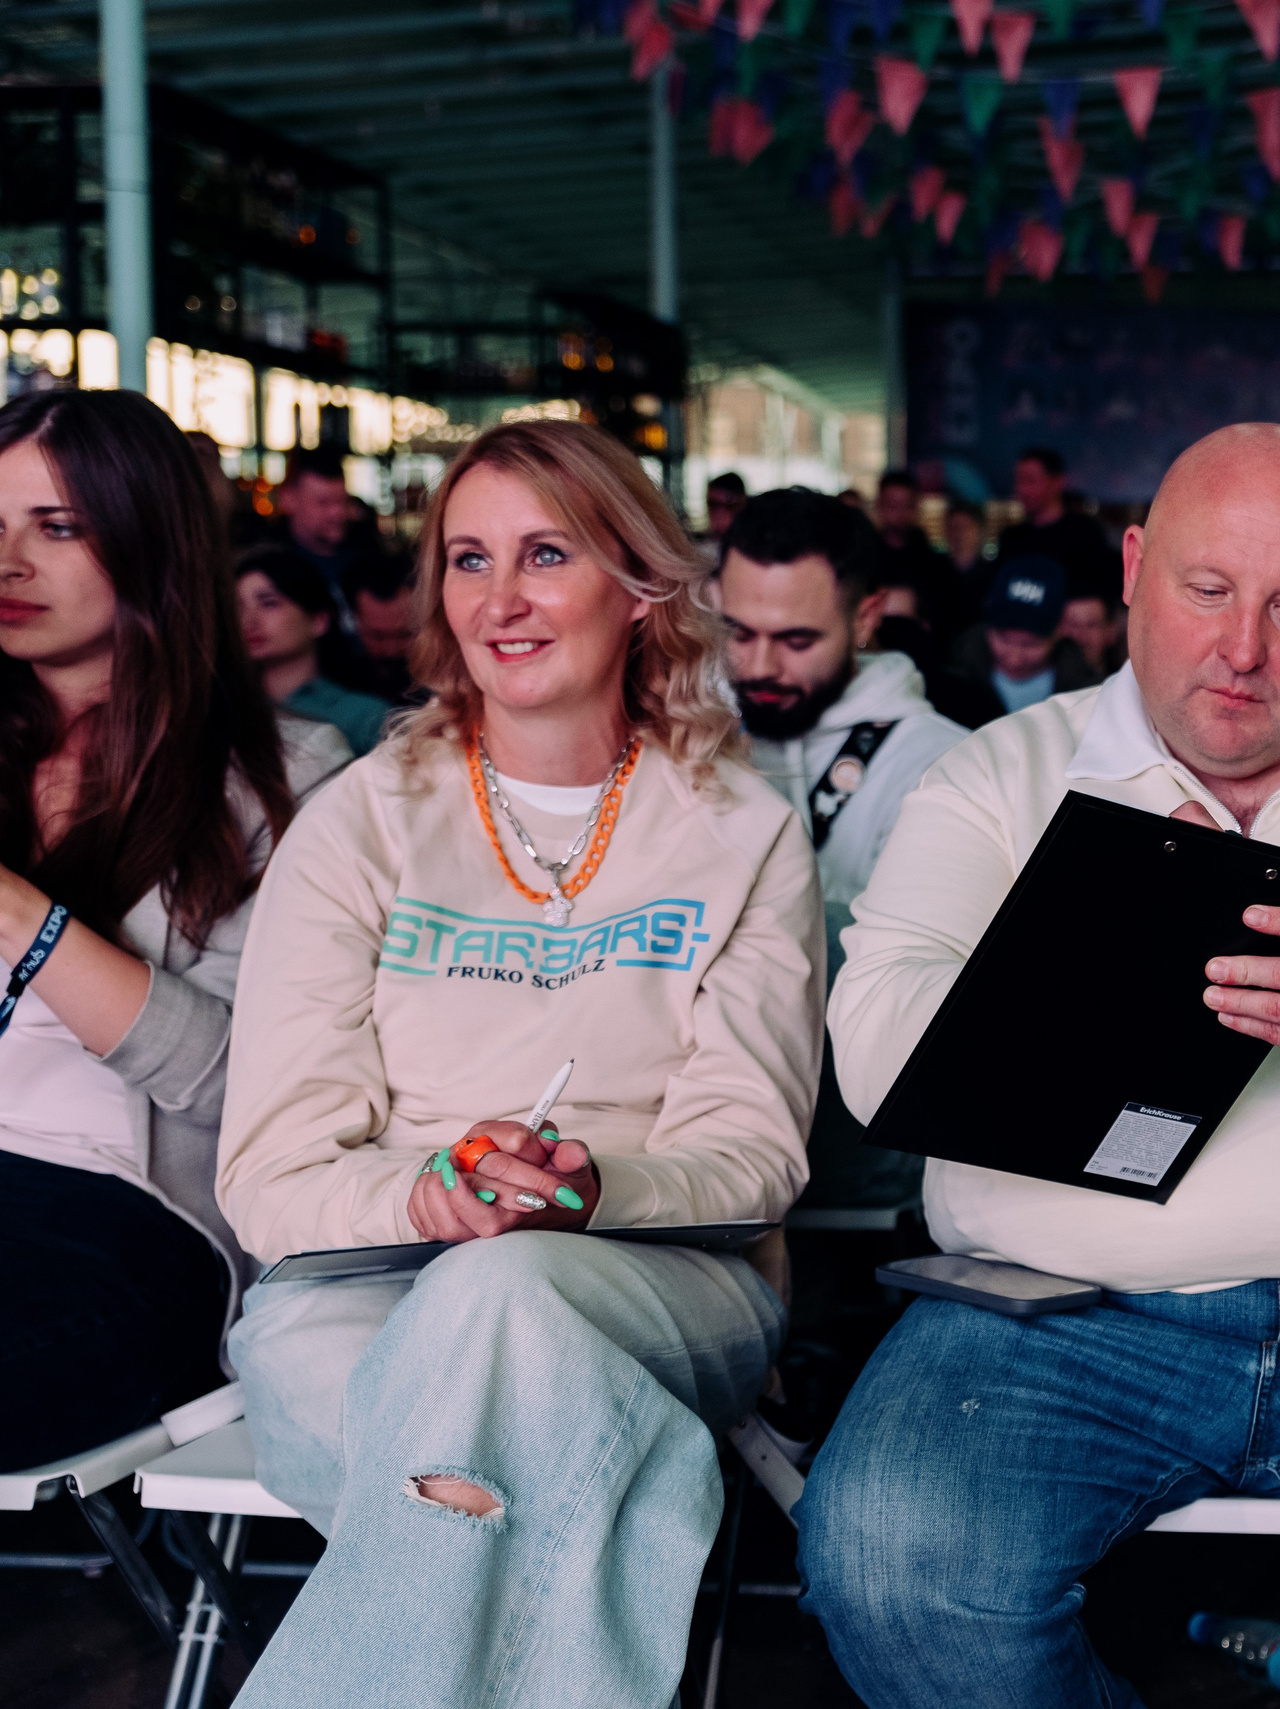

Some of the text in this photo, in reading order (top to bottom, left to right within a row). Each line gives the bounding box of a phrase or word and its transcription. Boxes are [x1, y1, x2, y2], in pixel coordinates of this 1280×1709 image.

[40, 904, 67, 944] EXPO
[384, 911, 688, 975] STARBARS
[446, 958, 607, 991] FRUKO SCHULZ
[1139, 1106, 1183, 1121] ErichKrause
